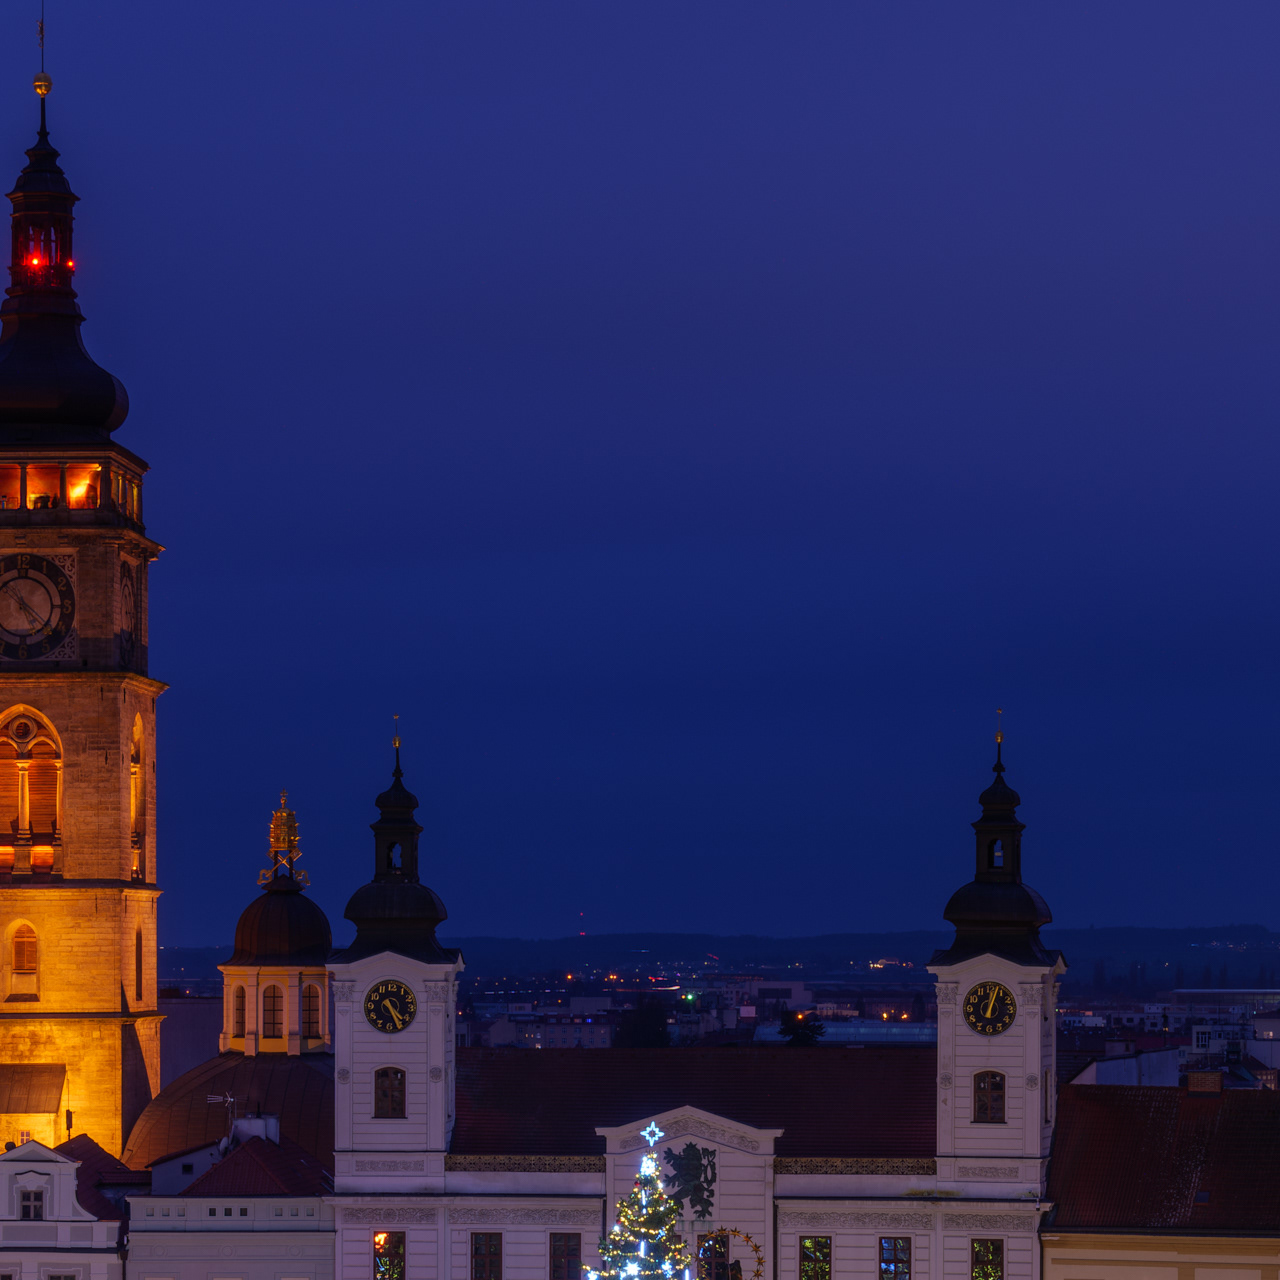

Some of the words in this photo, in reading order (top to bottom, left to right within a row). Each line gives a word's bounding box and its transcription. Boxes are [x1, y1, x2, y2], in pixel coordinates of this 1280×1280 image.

[17, 554, 30, 569] 12
[42, 560, 47, 573] 1
[57, 577, 67, 591] 2
[63, 599, 72, 614] 3
[57, 621, 67, 636] 4
[18, 645, 27, 659] 6
[41, 639, 50, 653] 5
